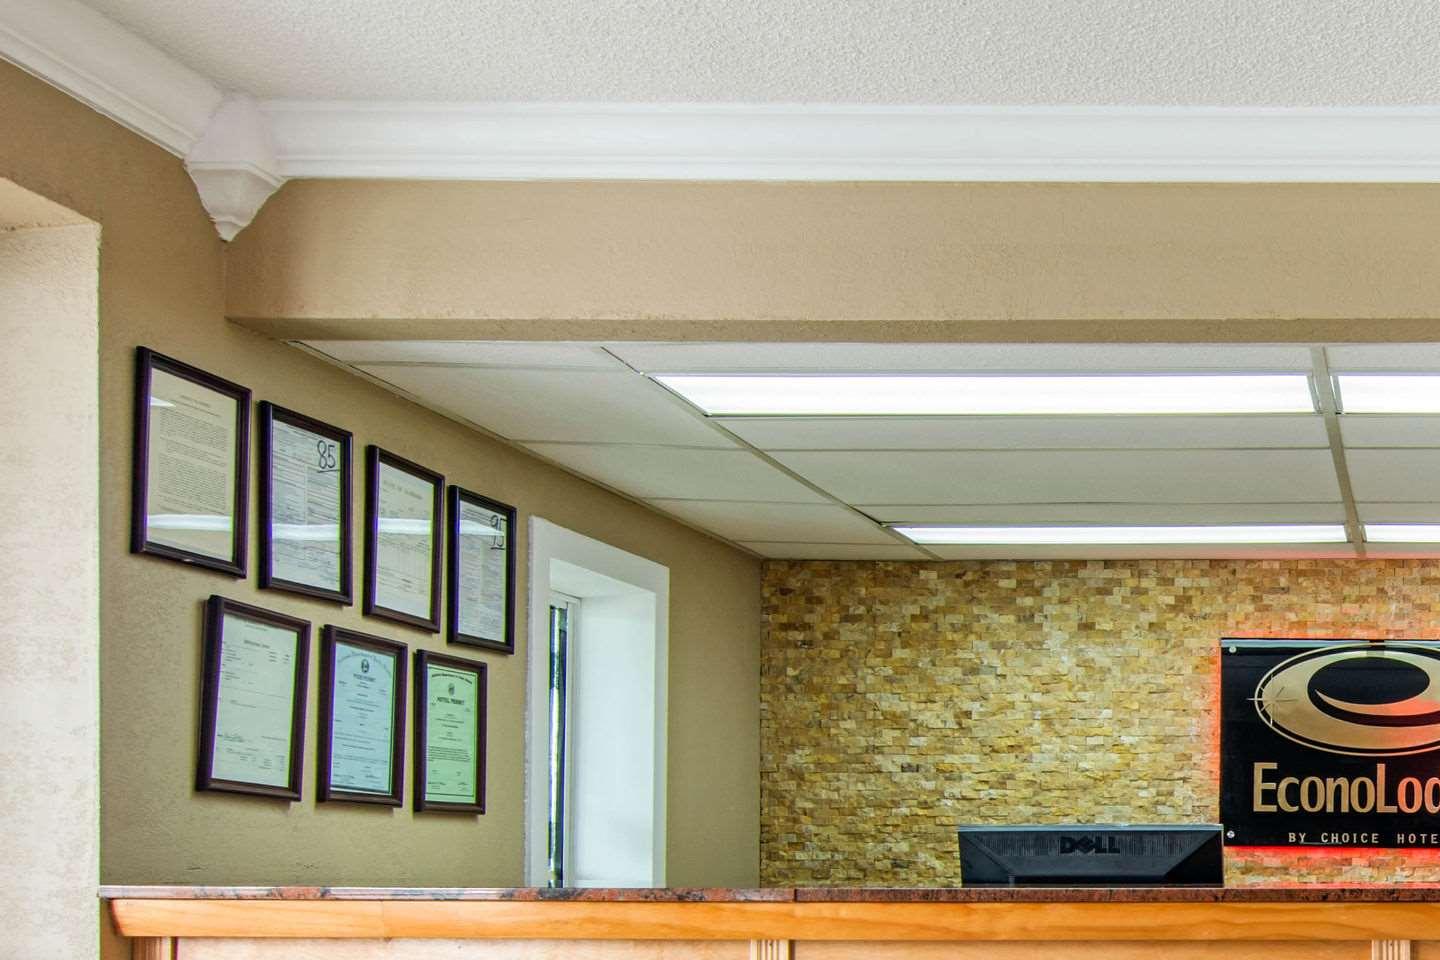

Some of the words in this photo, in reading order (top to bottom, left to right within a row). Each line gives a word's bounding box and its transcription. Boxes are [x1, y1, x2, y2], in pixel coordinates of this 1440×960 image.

[317, 440, 336, 469] 85
[1060, 835, 1120, 854] DELL
[1288, 832, 1306, 844] BY
[1320, 832, 1380, 844] CHOICE
